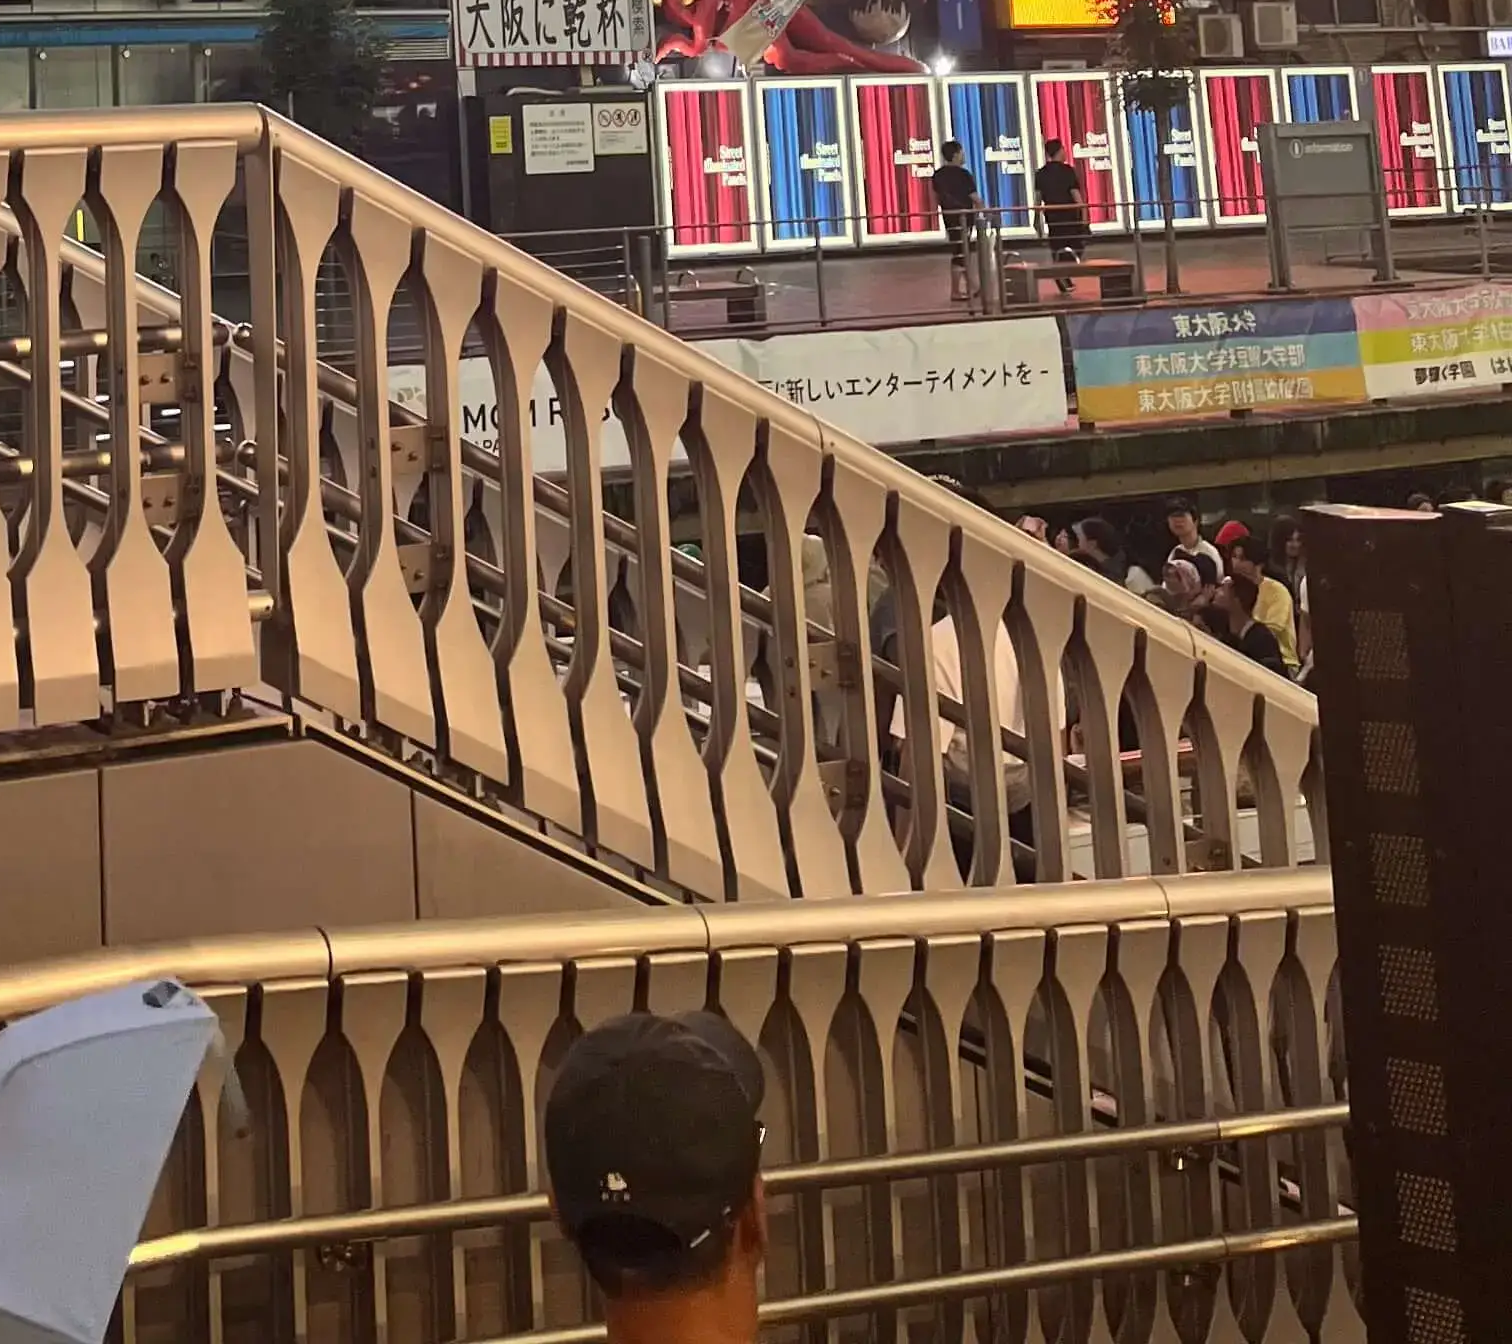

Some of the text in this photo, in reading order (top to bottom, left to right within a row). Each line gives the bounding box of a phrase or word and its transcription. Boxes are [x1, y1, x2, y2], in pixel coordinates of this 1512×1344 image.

[1172, 309, 1256, 338] 東大阪大学
